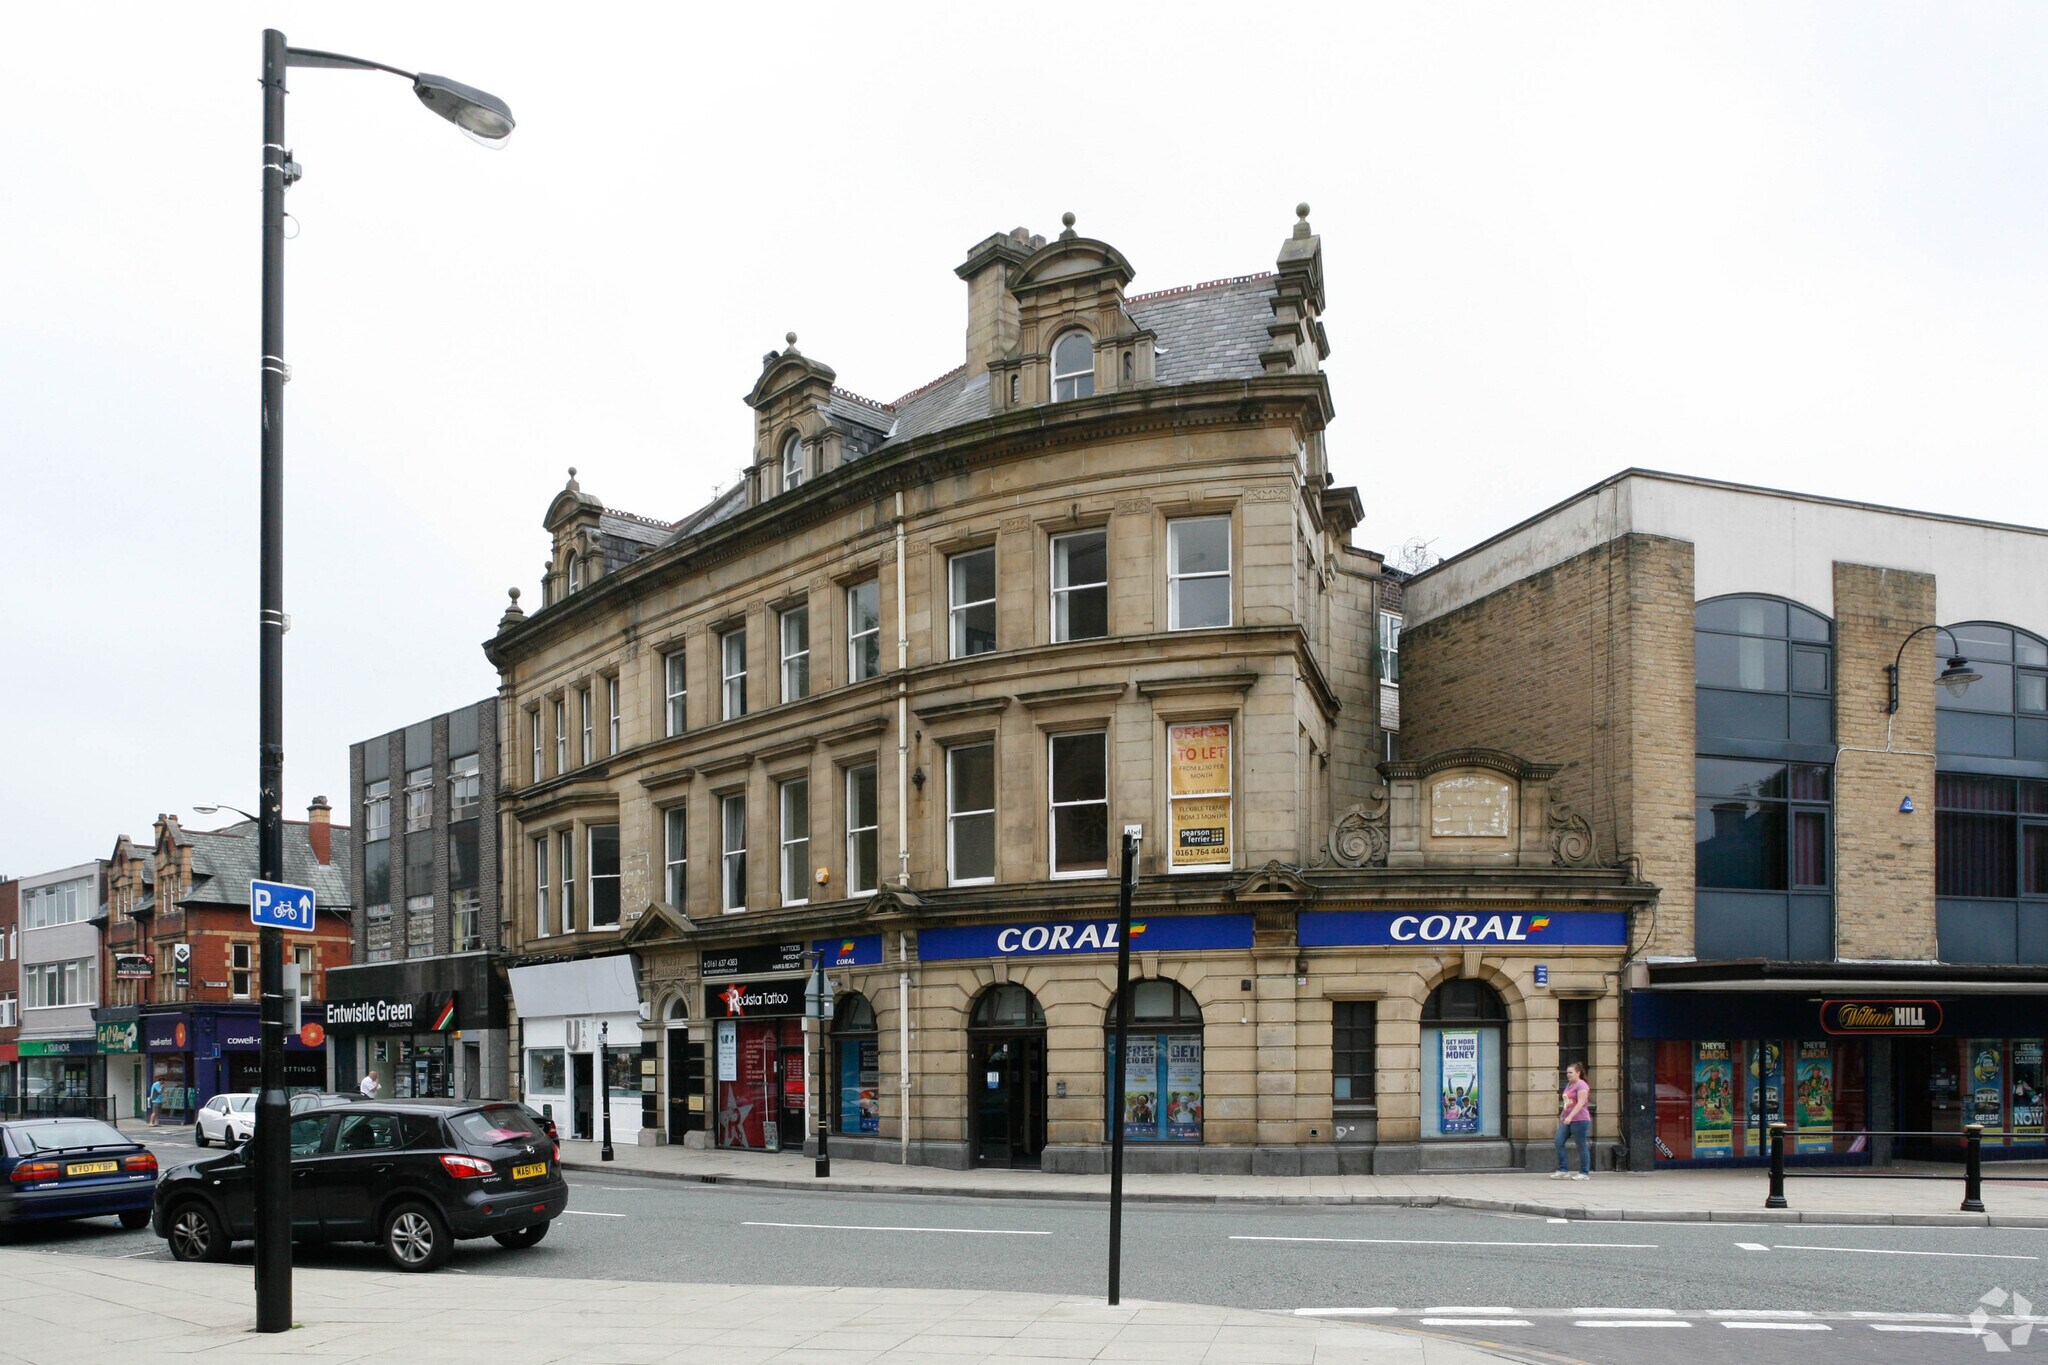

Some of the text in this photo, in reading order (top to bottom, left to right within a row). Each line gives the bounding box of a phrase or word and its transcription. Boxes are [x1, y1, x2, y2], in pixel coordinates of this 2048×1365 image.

[1173, 725, 1229, 739] OFFICES
[1177, 746, 1226, 761] TO LET
[1181, 829, 1210, 838] pearson
[255, 890, 271, 916] P
[1390, 915, 1527, 941] CORAL
[997, 923, 1119, 952] CORAL
[707, 960, 718, 968] 0161
[718, 959, 726, 967] 637
[727, 958, 738, 966] 4383
[727, 988, 788, 1015] Rockstar Tattoo
[327, 1000, 412, 1023] Entwistle Green
[1839, 1004, 1925, 1027] William HILL
[566, 1020, 580, 1050] U
[1126, 1045, 1154, 1057] FREE
[1701, 1042, 1726, 1050] THEY'RE
[1126, 1056, 1154, 1065] £10 BET
[1446, 1051, 1475, 1059] MONEY
[1700, 1050, 1729, 1060] BACK!
[1801, 1049, 1828, 1059] BACK!
[2014, 1112, 2043, 1125] NOW
[71, 1162, 114, 1174] W707 YBP
